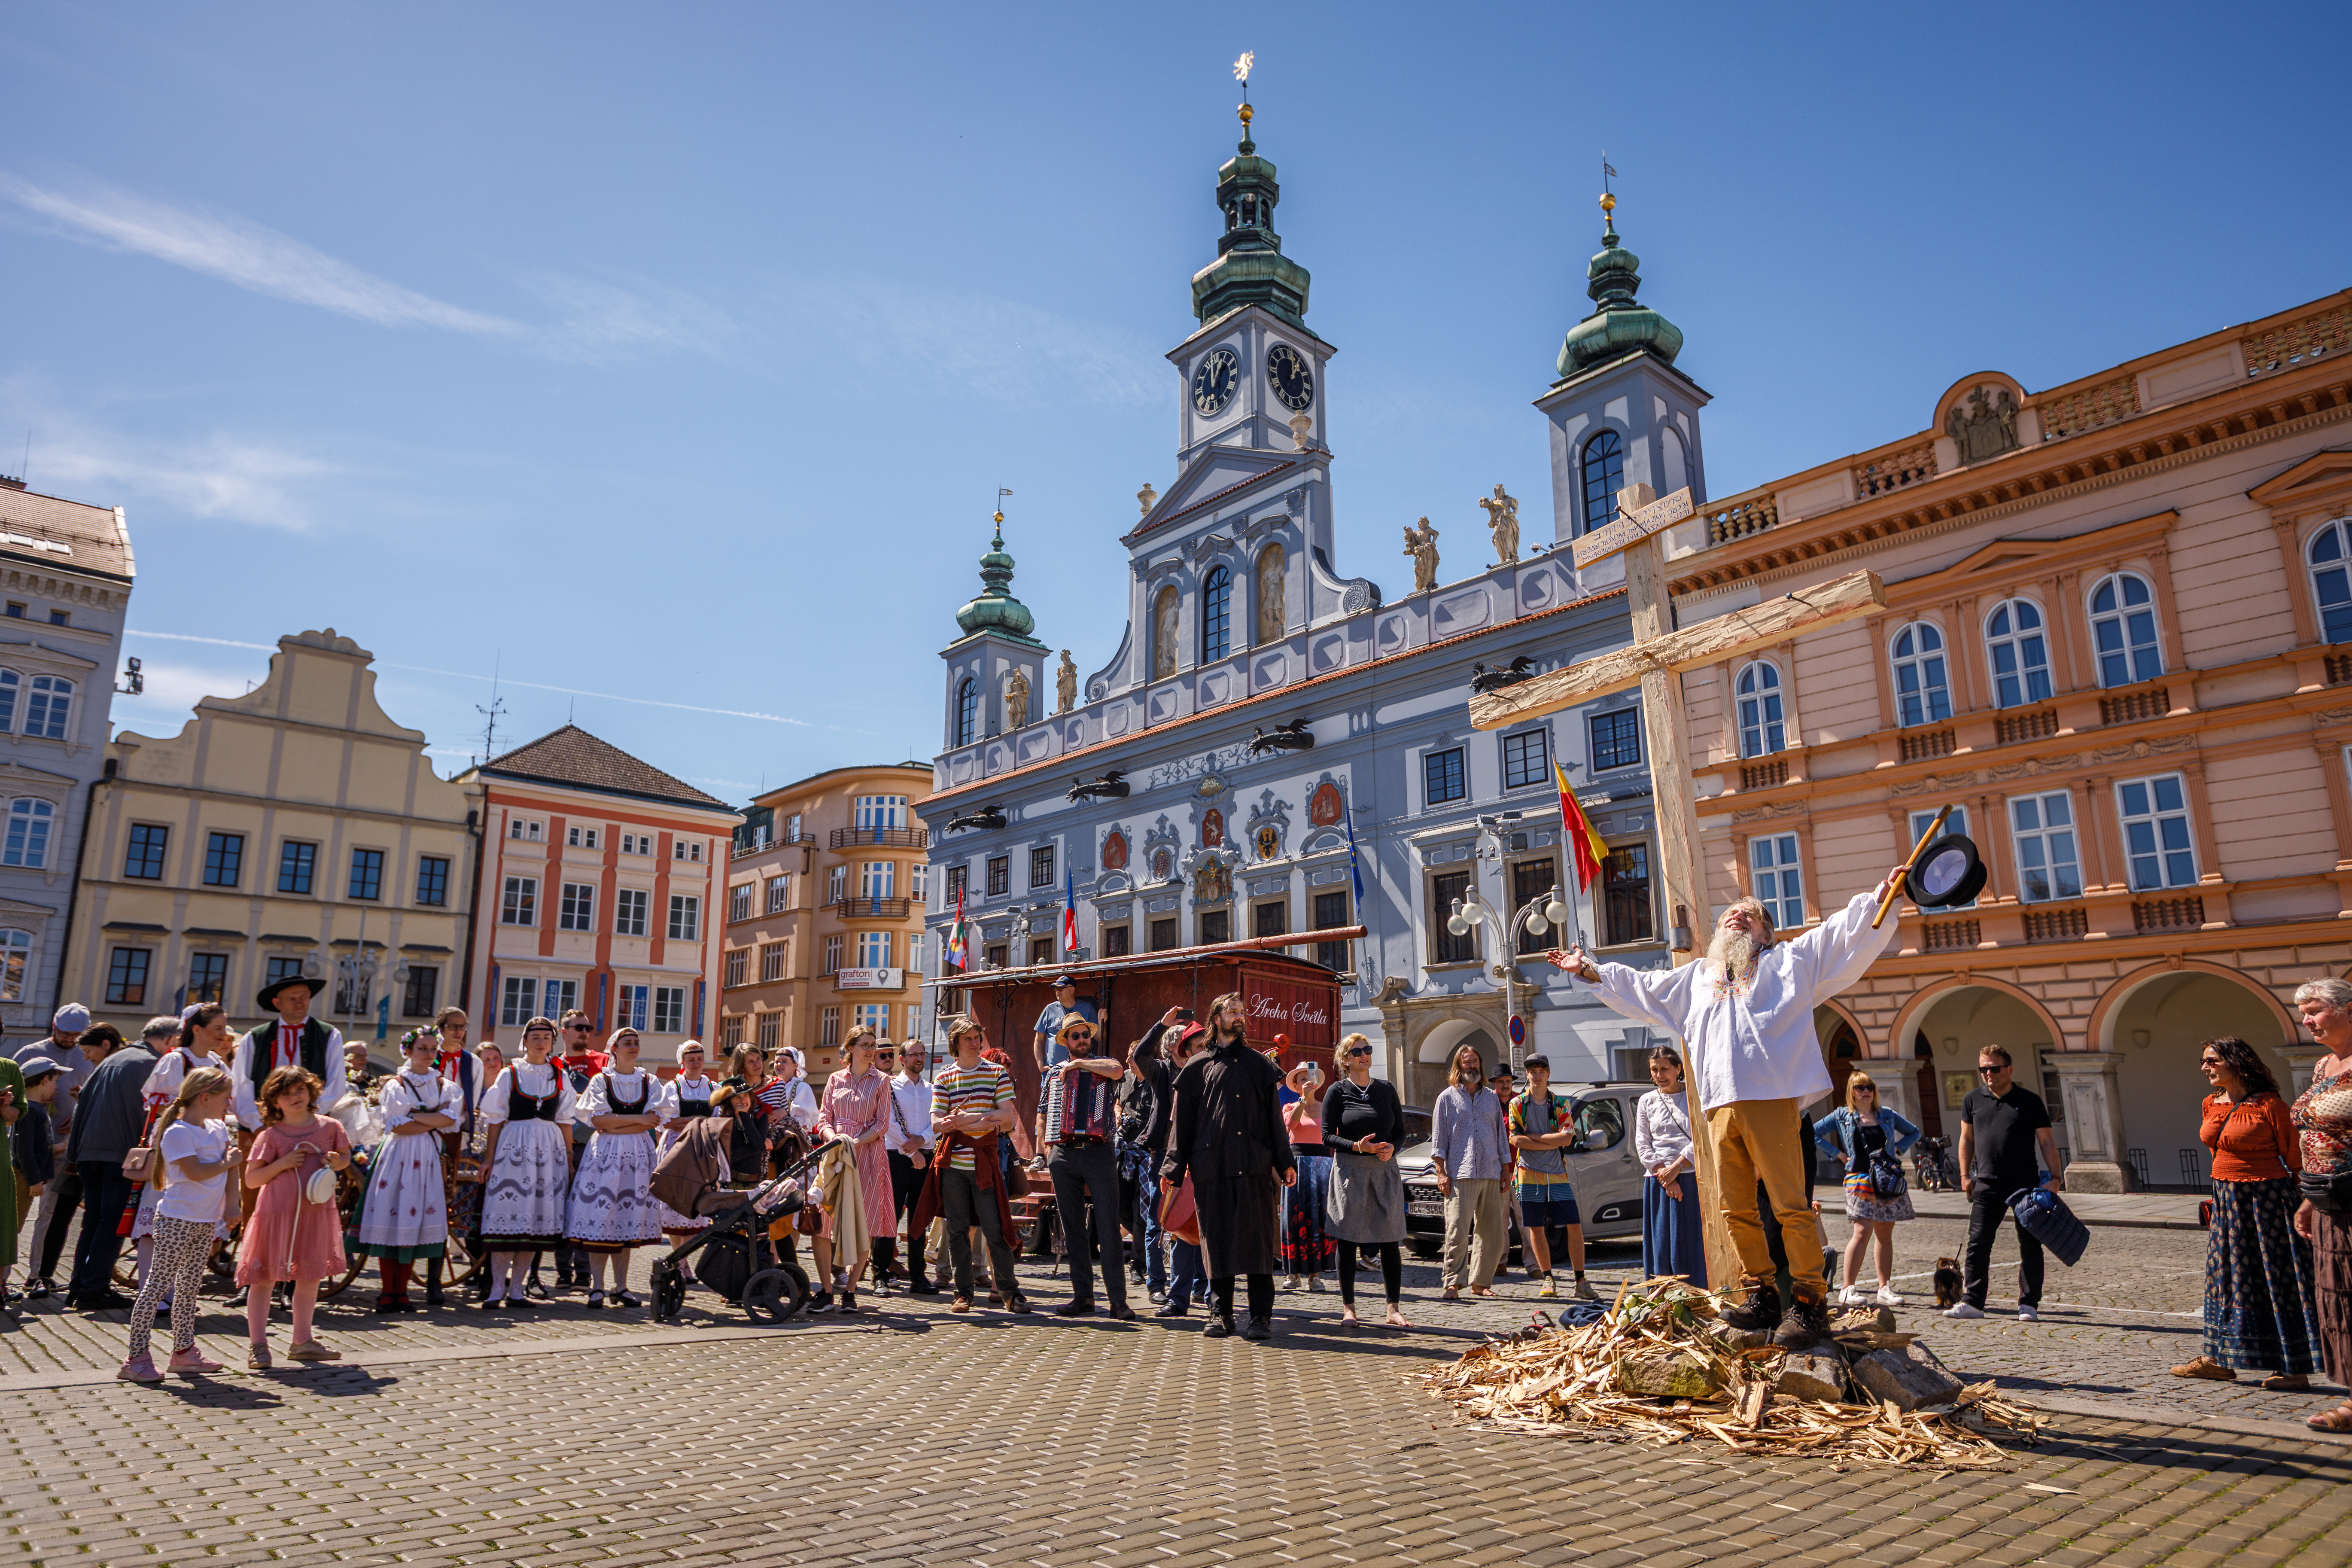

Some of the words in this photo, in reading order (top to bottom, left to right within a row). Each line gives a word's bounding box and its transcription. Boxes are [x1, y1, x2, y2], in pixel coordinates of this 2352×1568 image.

[1228, 357, 1235, 366] II
[841, 969, 870, 980] grafton
[1246, 993, 1288, 1020] Archa
[1292, 1002, 1328, 1025] Světla
[1409, 1204, 1421, 1213] 8C4
[1426, 1205, 1442, 1214] 9464
